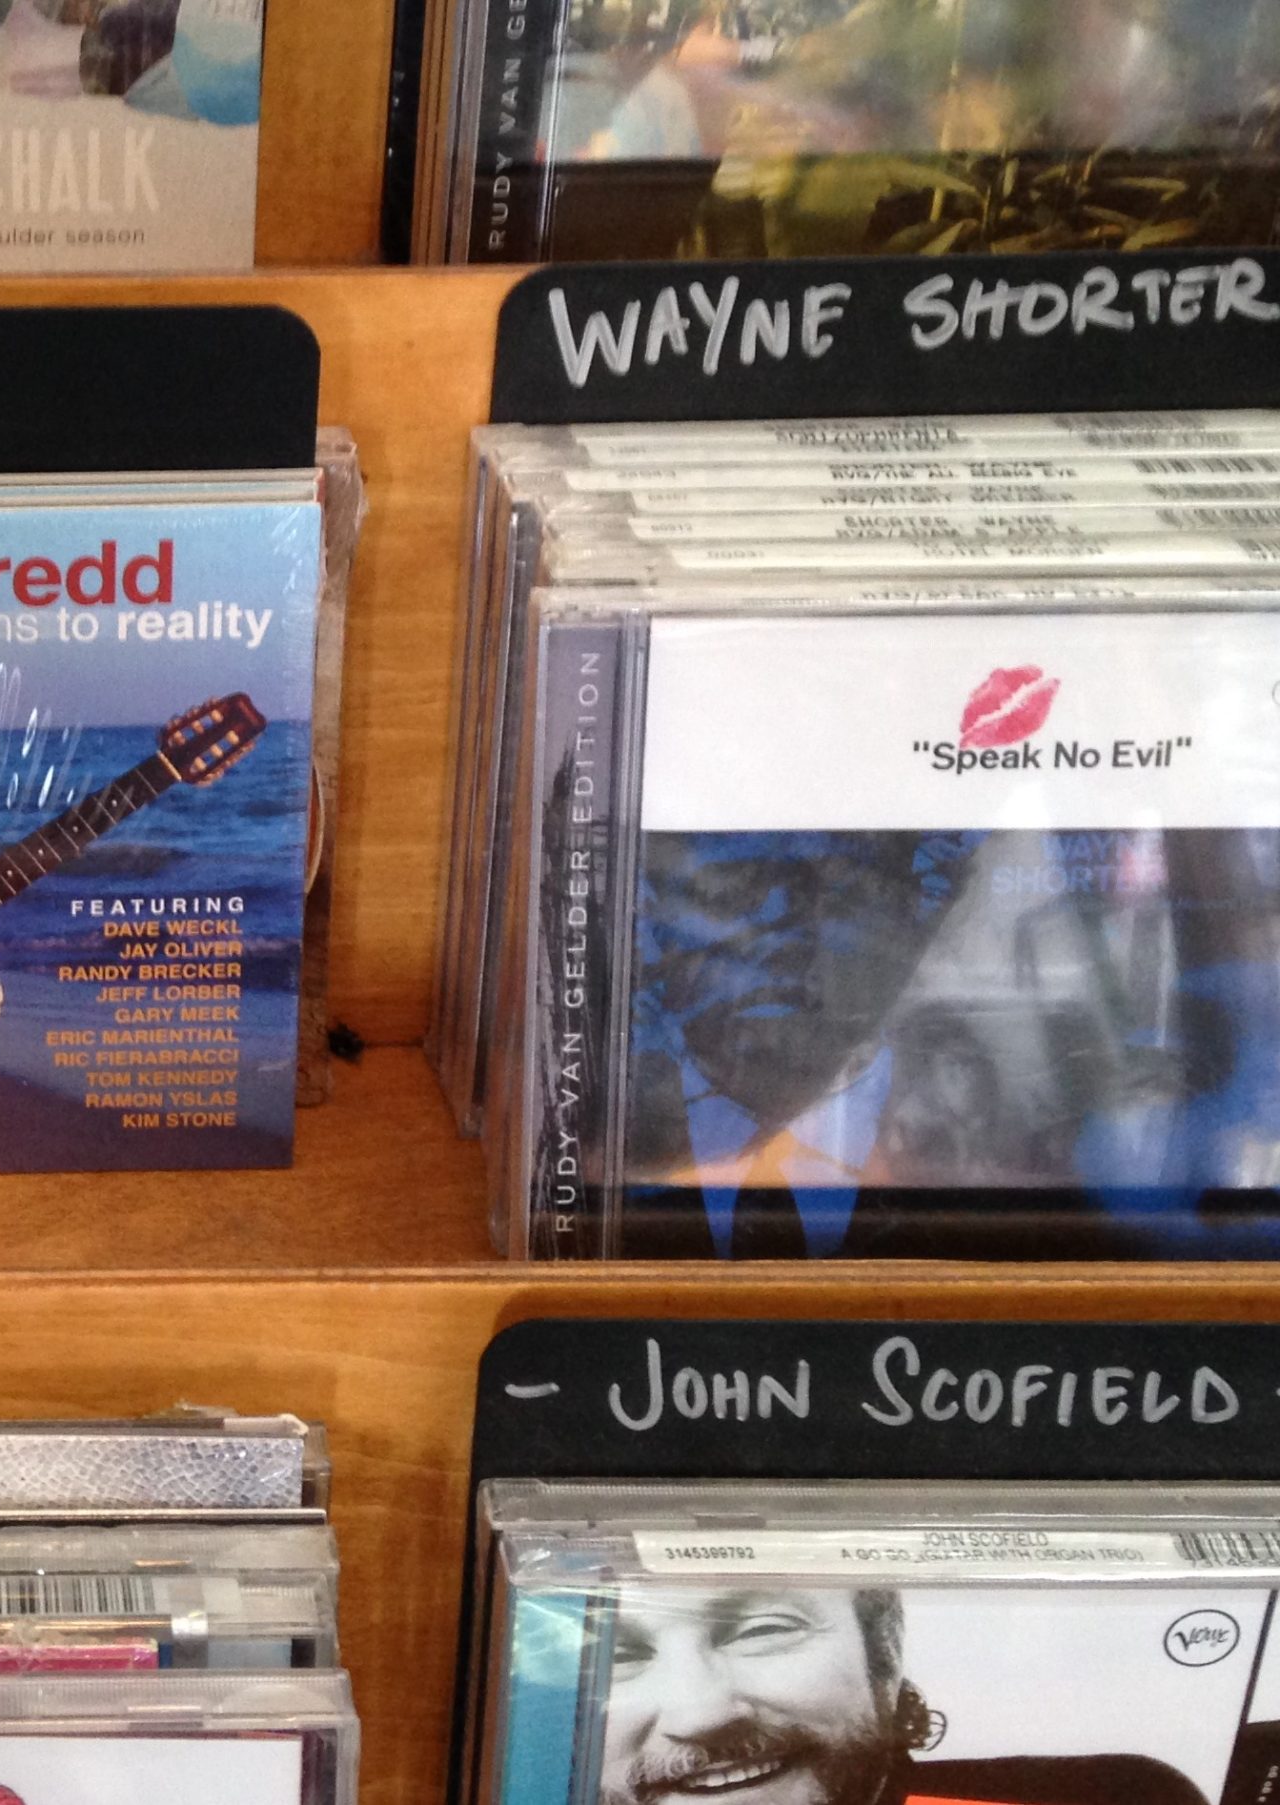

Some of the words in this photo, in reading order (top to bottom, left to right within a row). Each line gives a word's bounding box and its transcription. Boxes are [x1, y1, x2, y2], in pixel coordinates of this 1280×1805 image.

[498, 58, 521, 136] VAN
[488, 151, 513, 250] RUDY
[65, 227, 146, 246] season
[548, 276, 852, 388] WAYNE
[903, 258, 1280, 351] SHORTER
[57, 609, 99, 642] to
[117, 600, 273, 649] reality
[572, 652, 601, 824] EDITION
[1054, 740, 1100, 769] No
[70, 896, 245, 917] FEATURING
[103, 920, 161, 938] DAVE
[166, 919, 244, 936] WECKL
[564, 850, 592, 1009] GELDER
[119, 943, 158, 960] JAY
[163, 941, 244, 958] OLIVER
[58, 965, 133, 982] RANDY
[138, 962, 242, 981] BRECKER
[95, 986, 148, 1003] JEFF
[153, 984, 241, 1001] LORBER
[114, 1006, 174, 1024] GARY
[180, 1005, 241, 1022] MEEK
[46, 1030, 97, 1047] ERIC
[102, 1027, 240, 1045] MARIENTHAL
[53, 1051, 90, 1067] RIC
[95, 1048, 240, 1066] FIERABRACCI
[86, 1071, 132, 1087] TOM
[137, 1070, 239, 1086] KENNEDY
[561, 1032, 583, 1109] VAN
[85, 1092, 164, 1108] RAMON
[169, 1090, 239, 1107] YSLAS
[122, 1113, 161, 1129] KIM
[166, 1111, 237, 1128] STONE
[555, 1131, 577, 1233] RUDY
[607, 1337, 812, 1432] JOHN
[860, 1335, 1241, 1428] SCOFIELD
[920, 1531, 966, 1548] JOHN
[969, 1531, 1050, 1547] SCOFIELD
